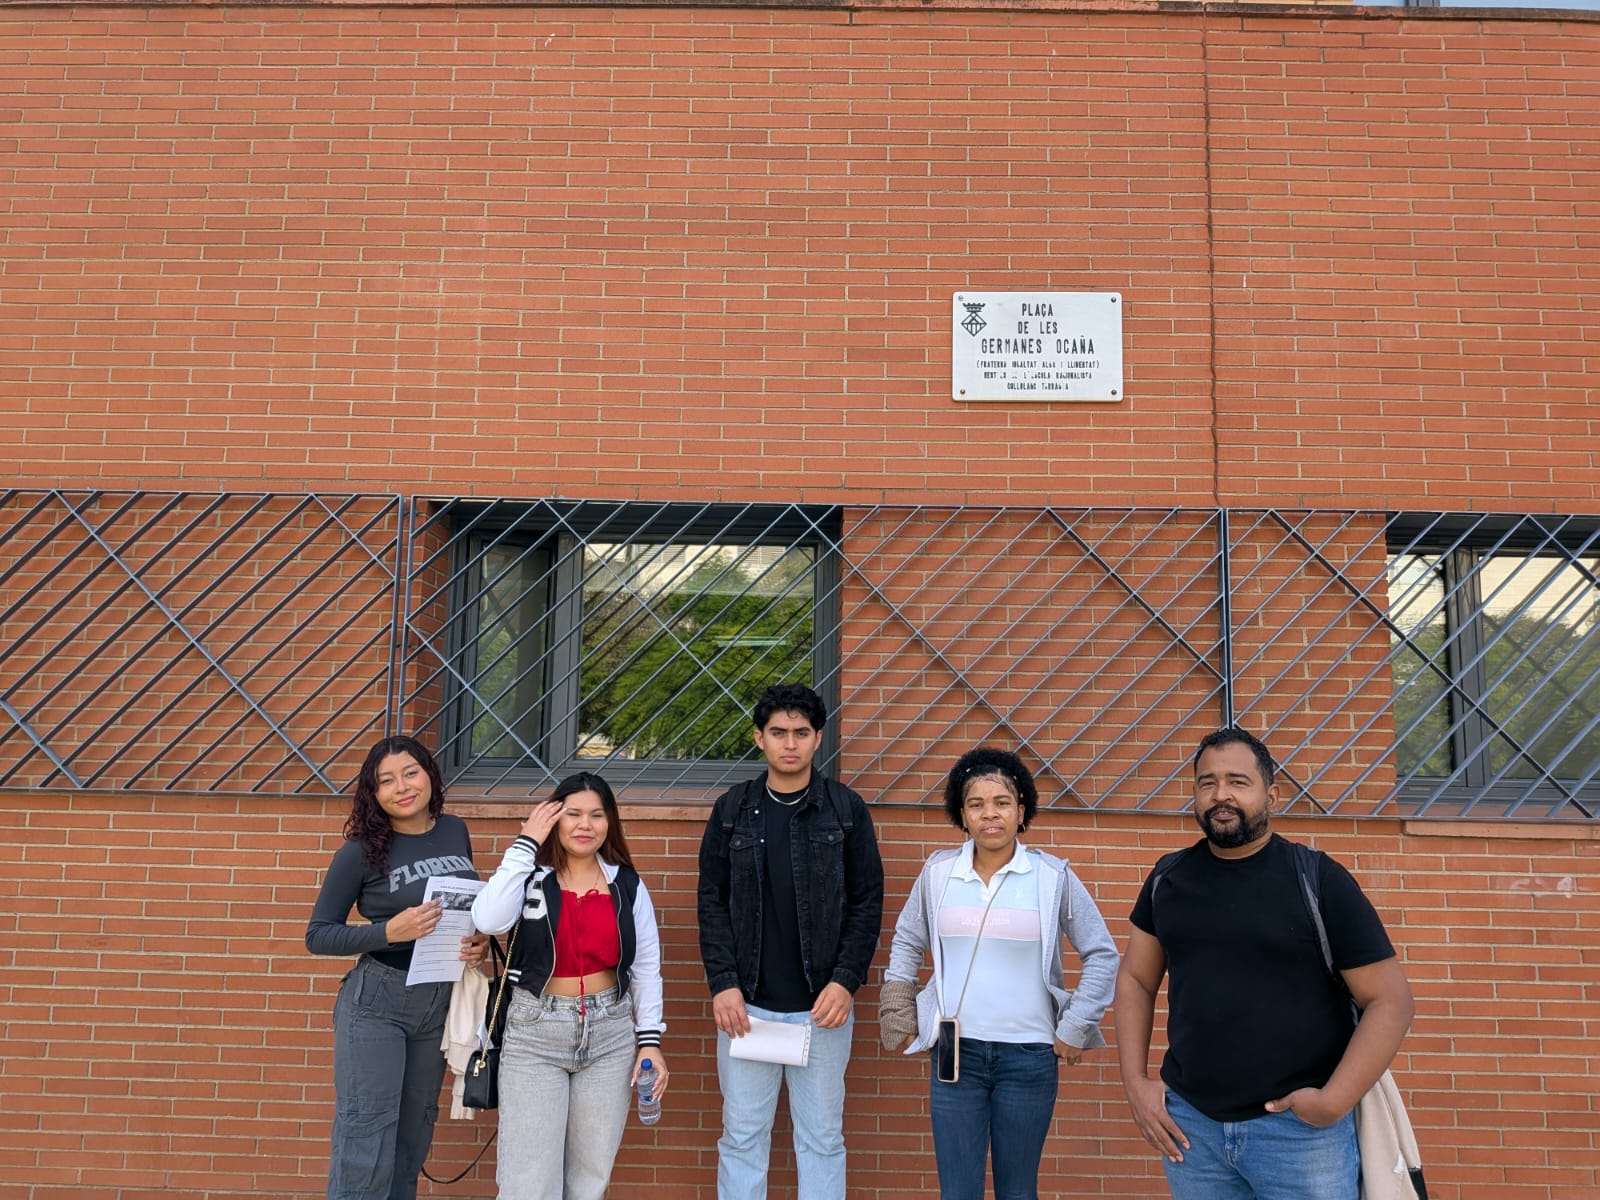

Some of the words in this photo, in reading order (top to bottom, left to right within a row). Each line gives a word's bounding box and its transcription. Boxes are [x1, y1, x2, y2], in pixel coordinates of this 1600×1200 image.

[1021, 303, 1054, 318] PLAÇA
[1017, 321, 1029, 334] DE
[1039, 321, 1058, 334] LES
[981, 338, 1042, 354] GERMANES
[1056, 335, 1095, 354] OCAÑA
